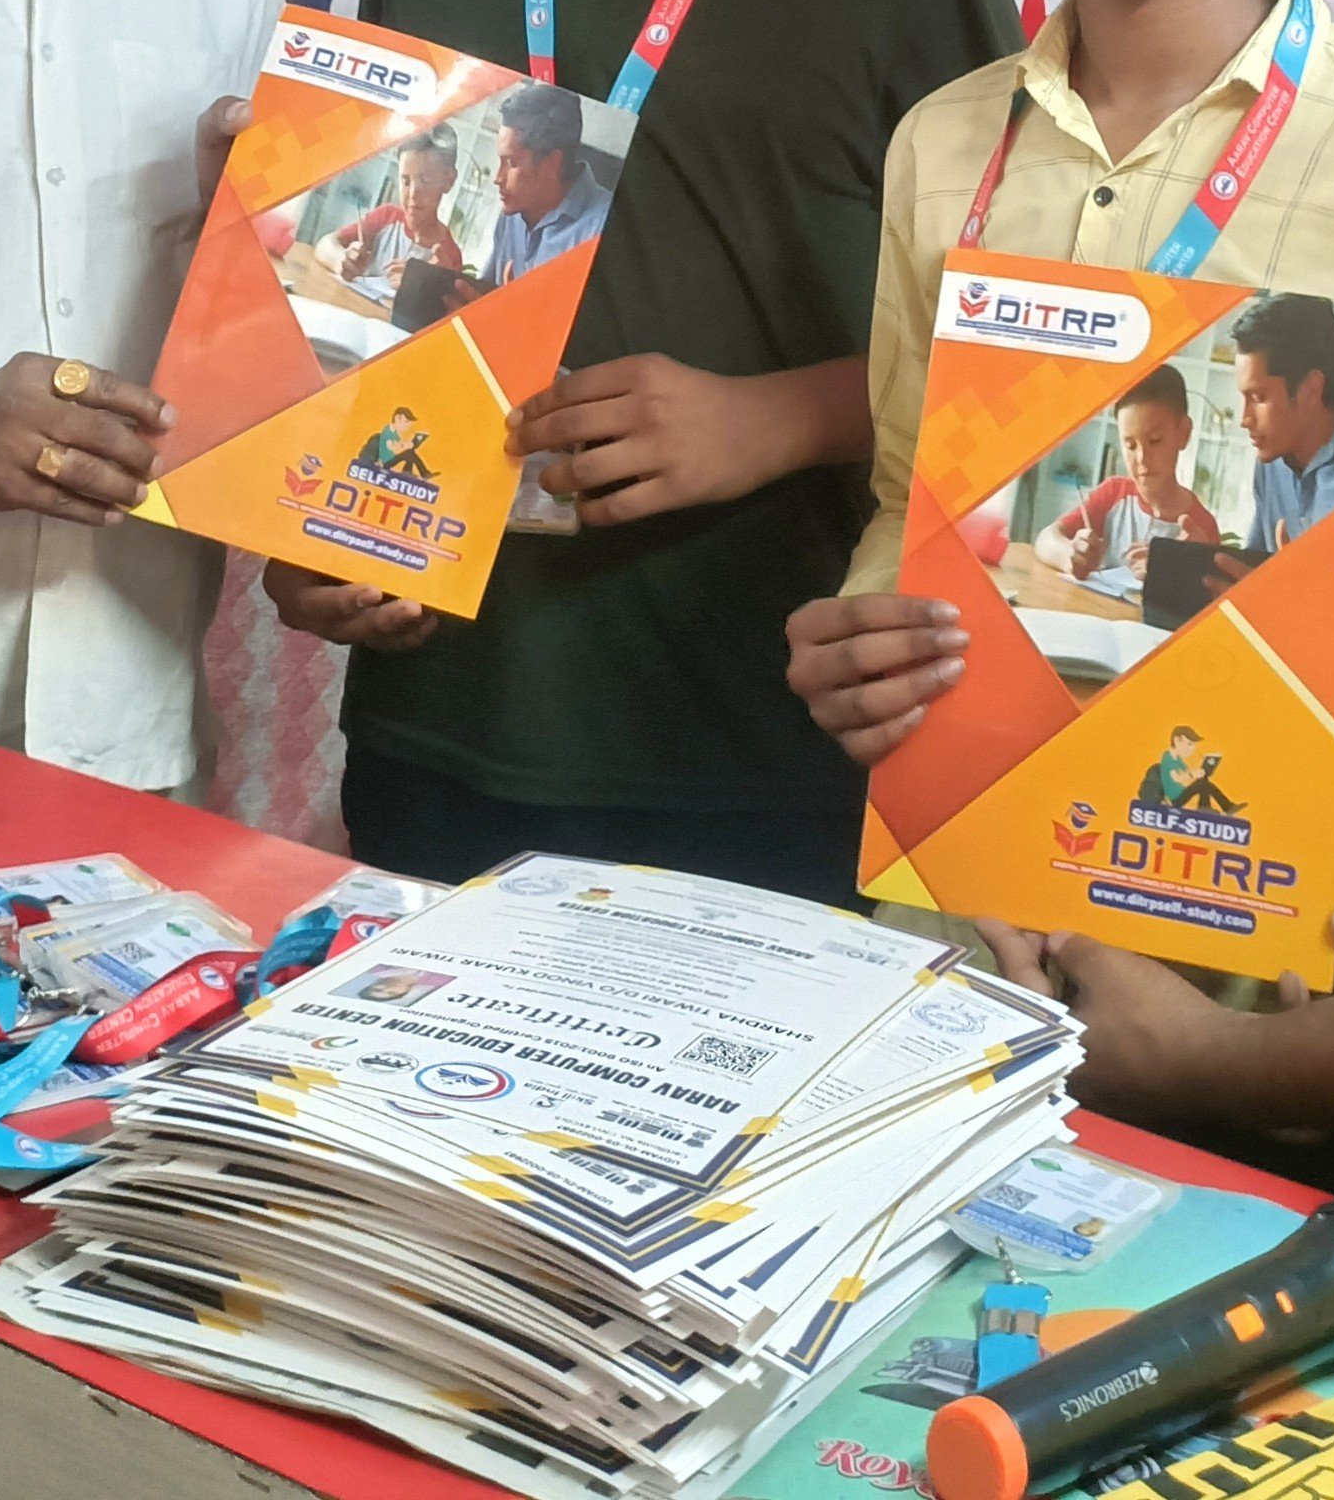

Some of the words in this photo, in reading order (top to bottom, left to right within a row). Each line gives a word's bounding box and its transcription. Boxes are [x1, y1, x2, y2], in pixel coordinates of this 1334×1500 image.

[348, 464, 438, 504] SELF-STUDY
[1130, 807, 1251, 844] SELF-STUDY
[291, 1002, 382, 1027] CENTER
[381, 1017, 515, 1054] EDUCATION
[514, 1044, 651, 1089] COMPUTER
[651, 1081, 742, 1115] AARAV
[1058, 1369, 1144, 1424] ZEBRONICS
